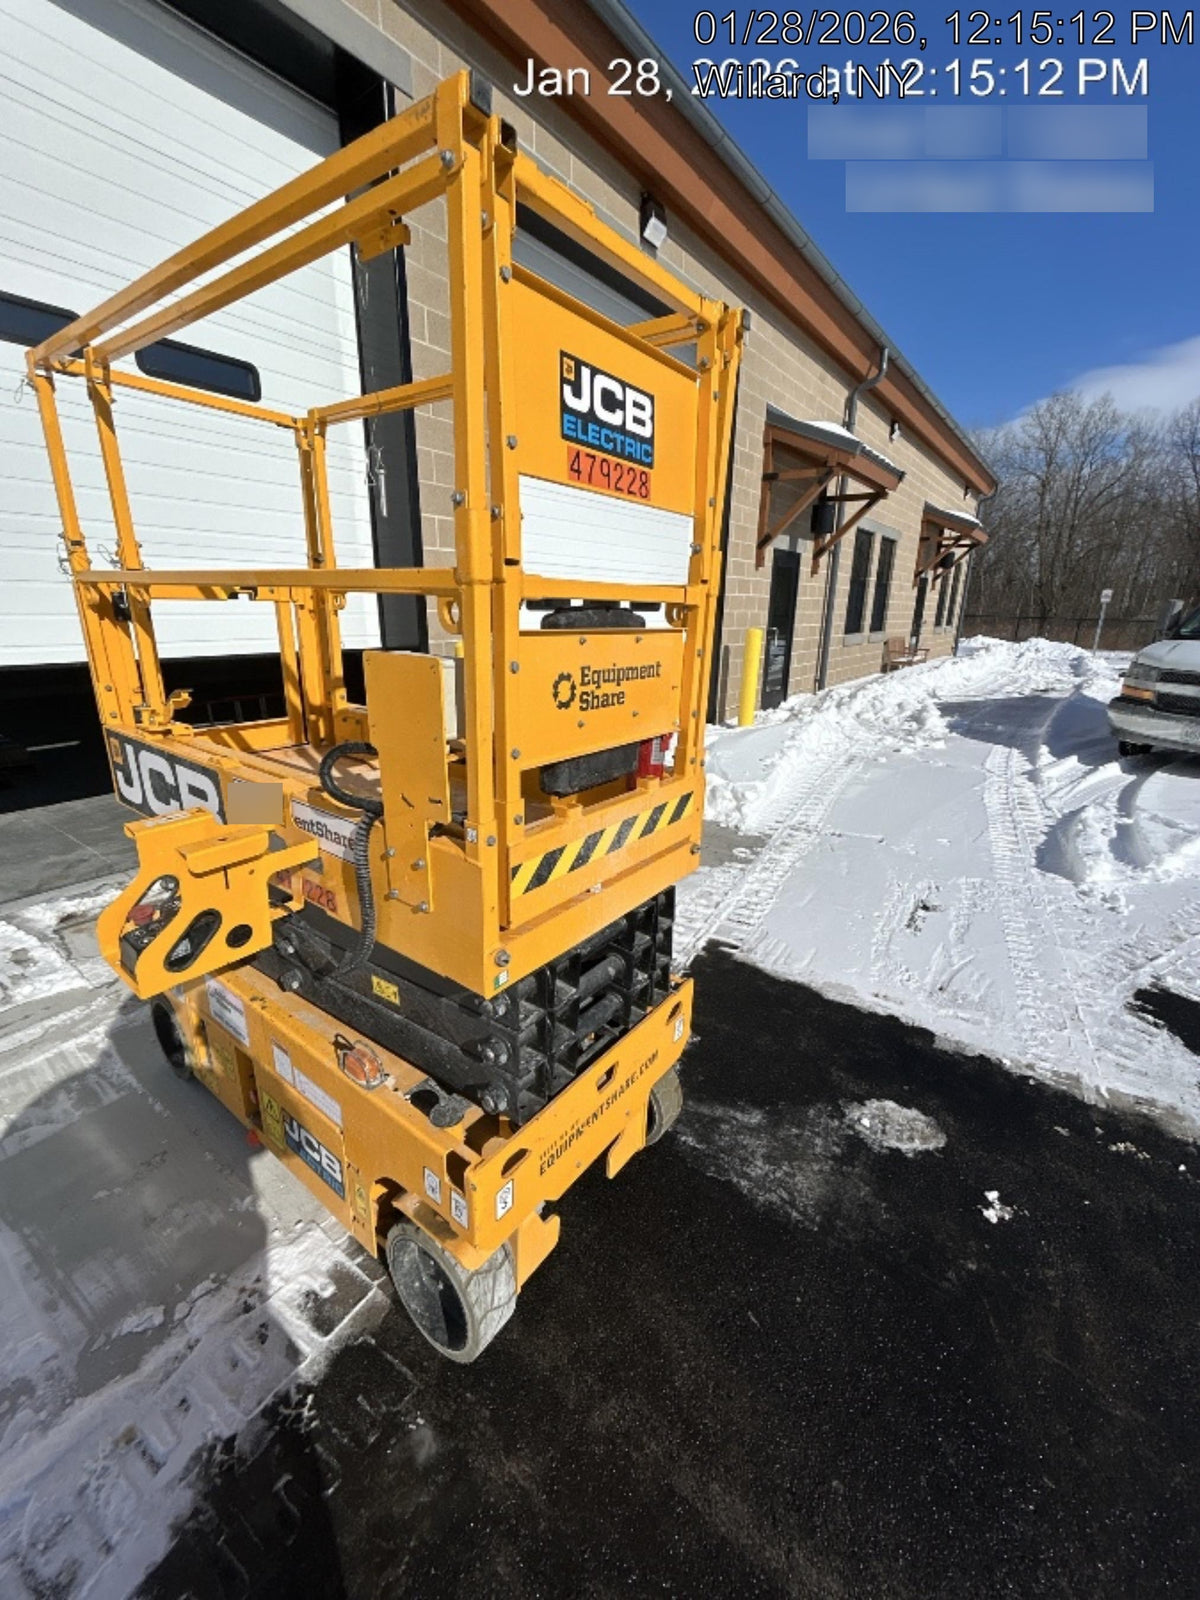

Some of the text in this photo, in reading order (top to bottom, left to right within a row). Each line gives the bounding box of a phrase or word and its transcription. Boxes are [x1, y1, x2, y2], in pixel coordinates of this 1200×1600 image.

[563, 365, 653, 438] JCB
[563, 413, 653, 464] ELECTRIC
[569, 450, 650, 500] 479228
[580, 660, 662, 690] Equipment
[579, 690, 626, 713] Share
[284, 1118, 343, 1184] JCB
